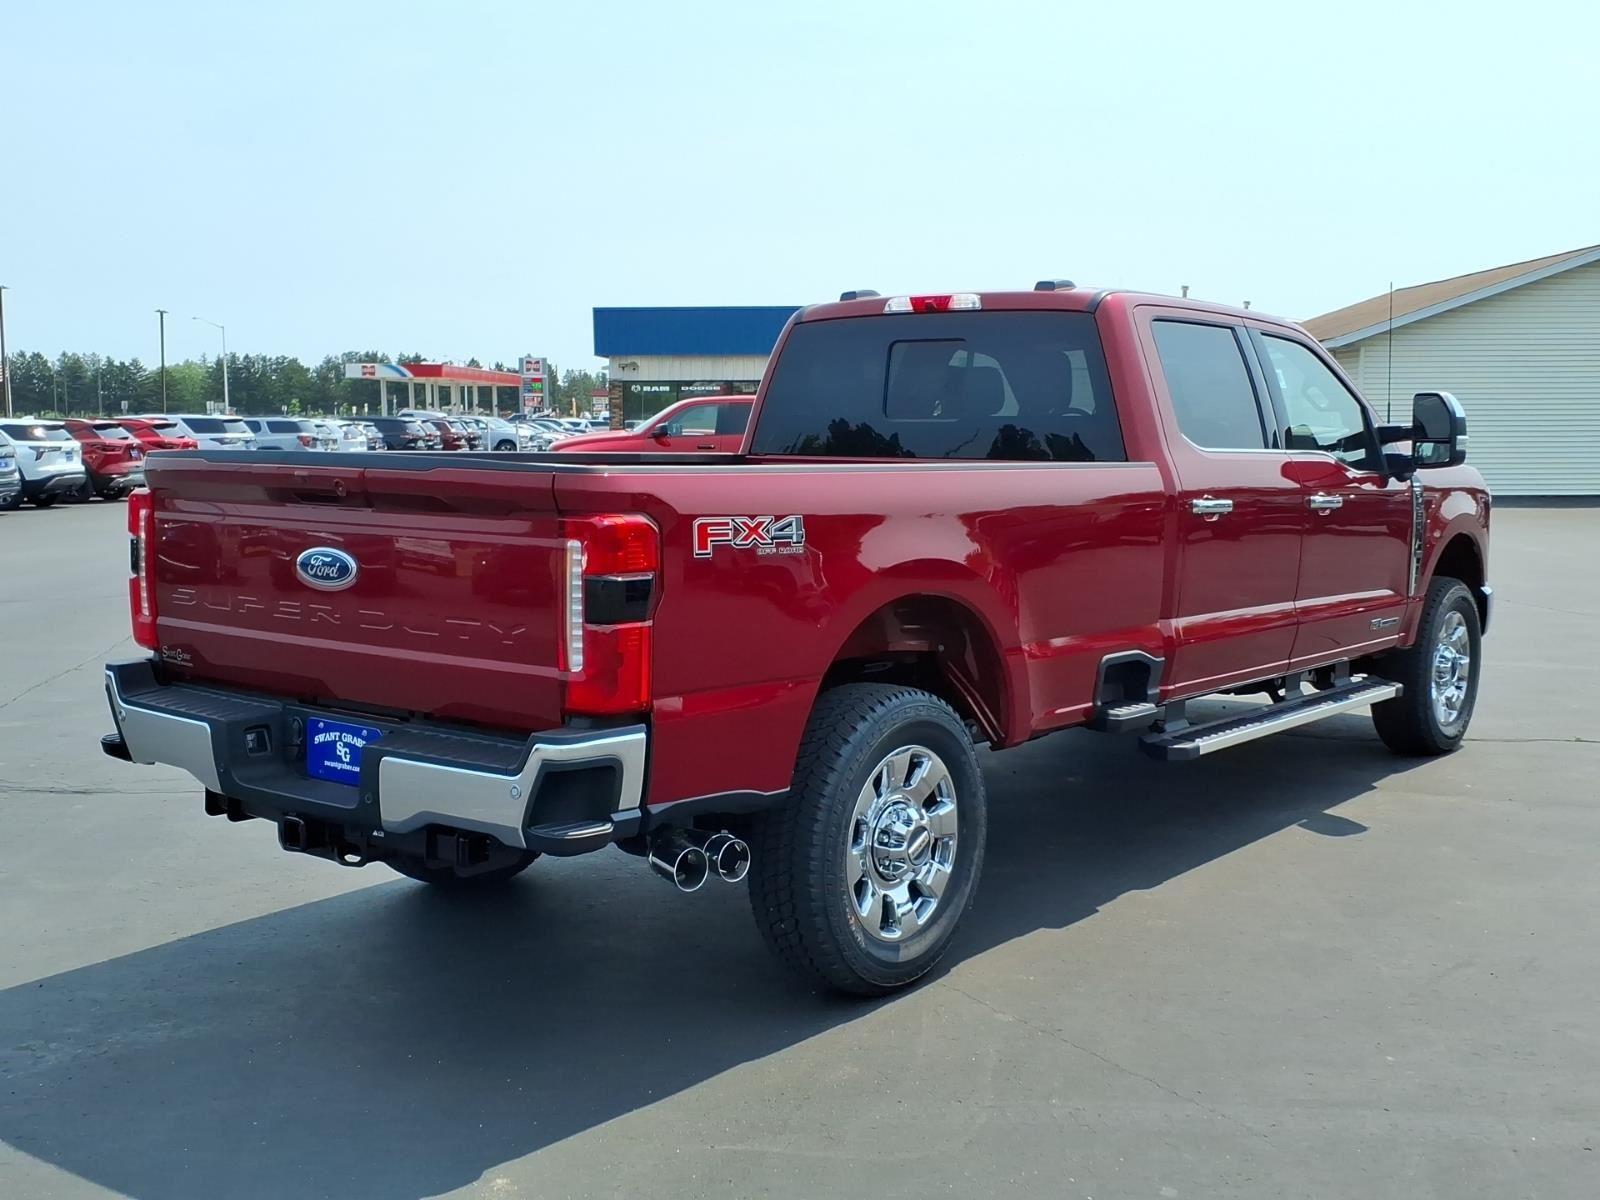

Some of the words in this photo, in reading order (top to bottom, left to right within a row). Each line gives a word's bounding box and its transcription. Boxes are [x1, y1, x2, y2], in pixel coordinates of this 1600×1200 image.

[693, 515, 805, 557] FX4
[307, 555, 340, 577] Ford
[171, 588, 341, 625] SUPER
[356, 609, 527, 644] DUTY
[314, 732, 340, 744] SWANT
[342, 733, 367, 748] GRAB
[336, 741, 351, 762] SG
